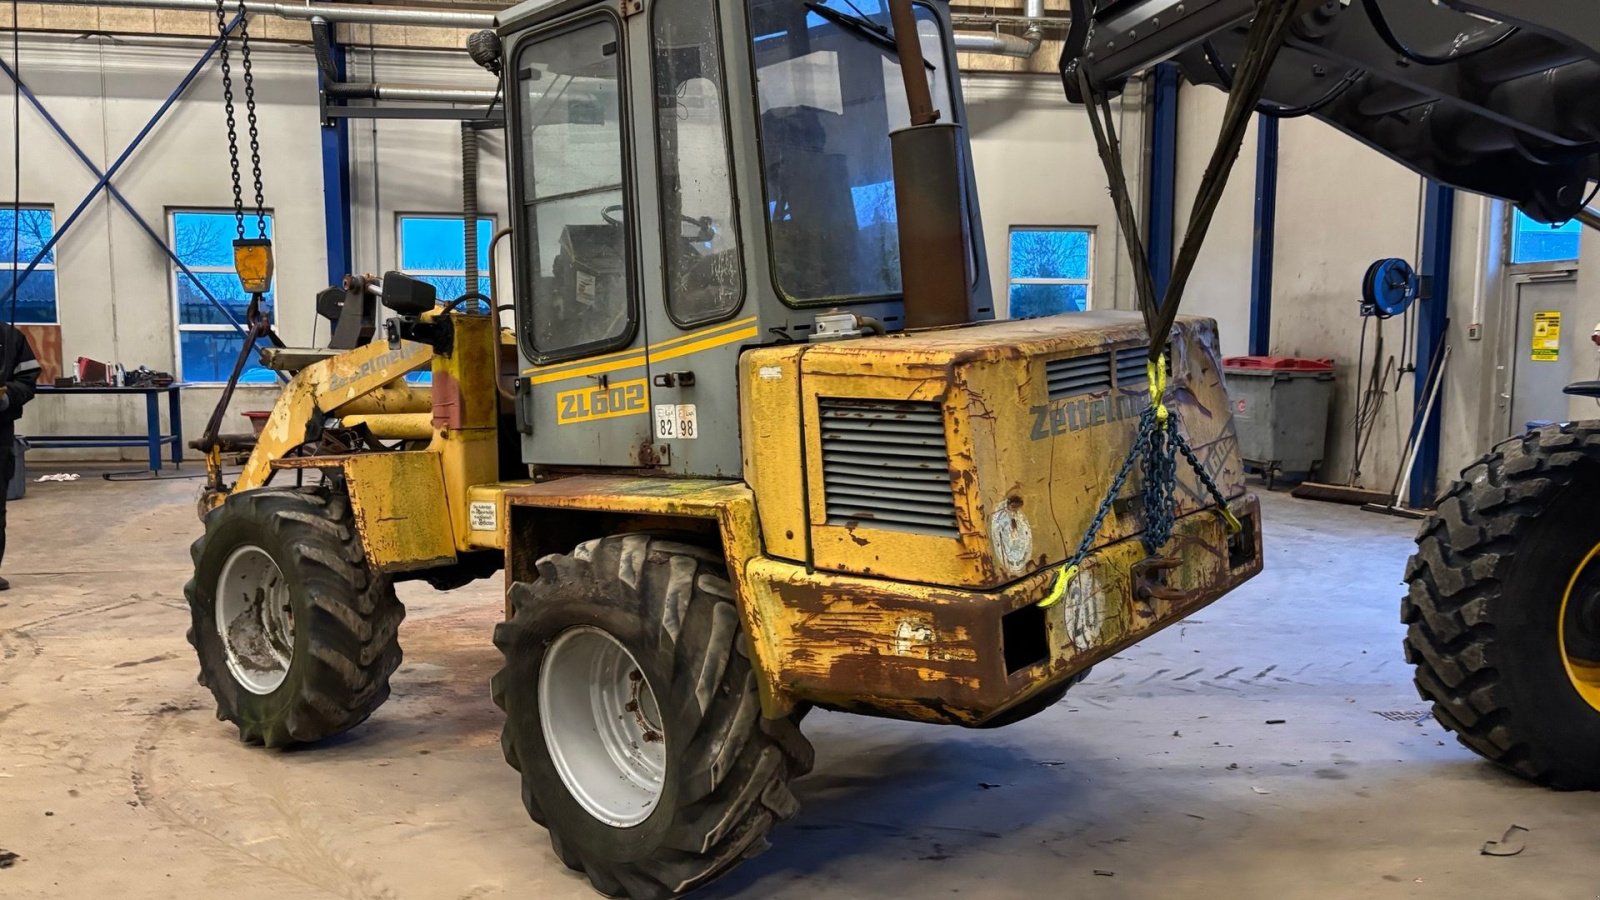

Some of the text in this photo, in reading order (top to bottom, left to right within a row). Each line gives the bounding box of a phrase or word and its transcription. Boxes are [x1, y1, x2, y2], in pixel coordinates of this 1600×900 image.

[561, 383, 645, 420] ZL602
[660, 419, 673, 436] 82
[680, 419, 694, 437] 98
